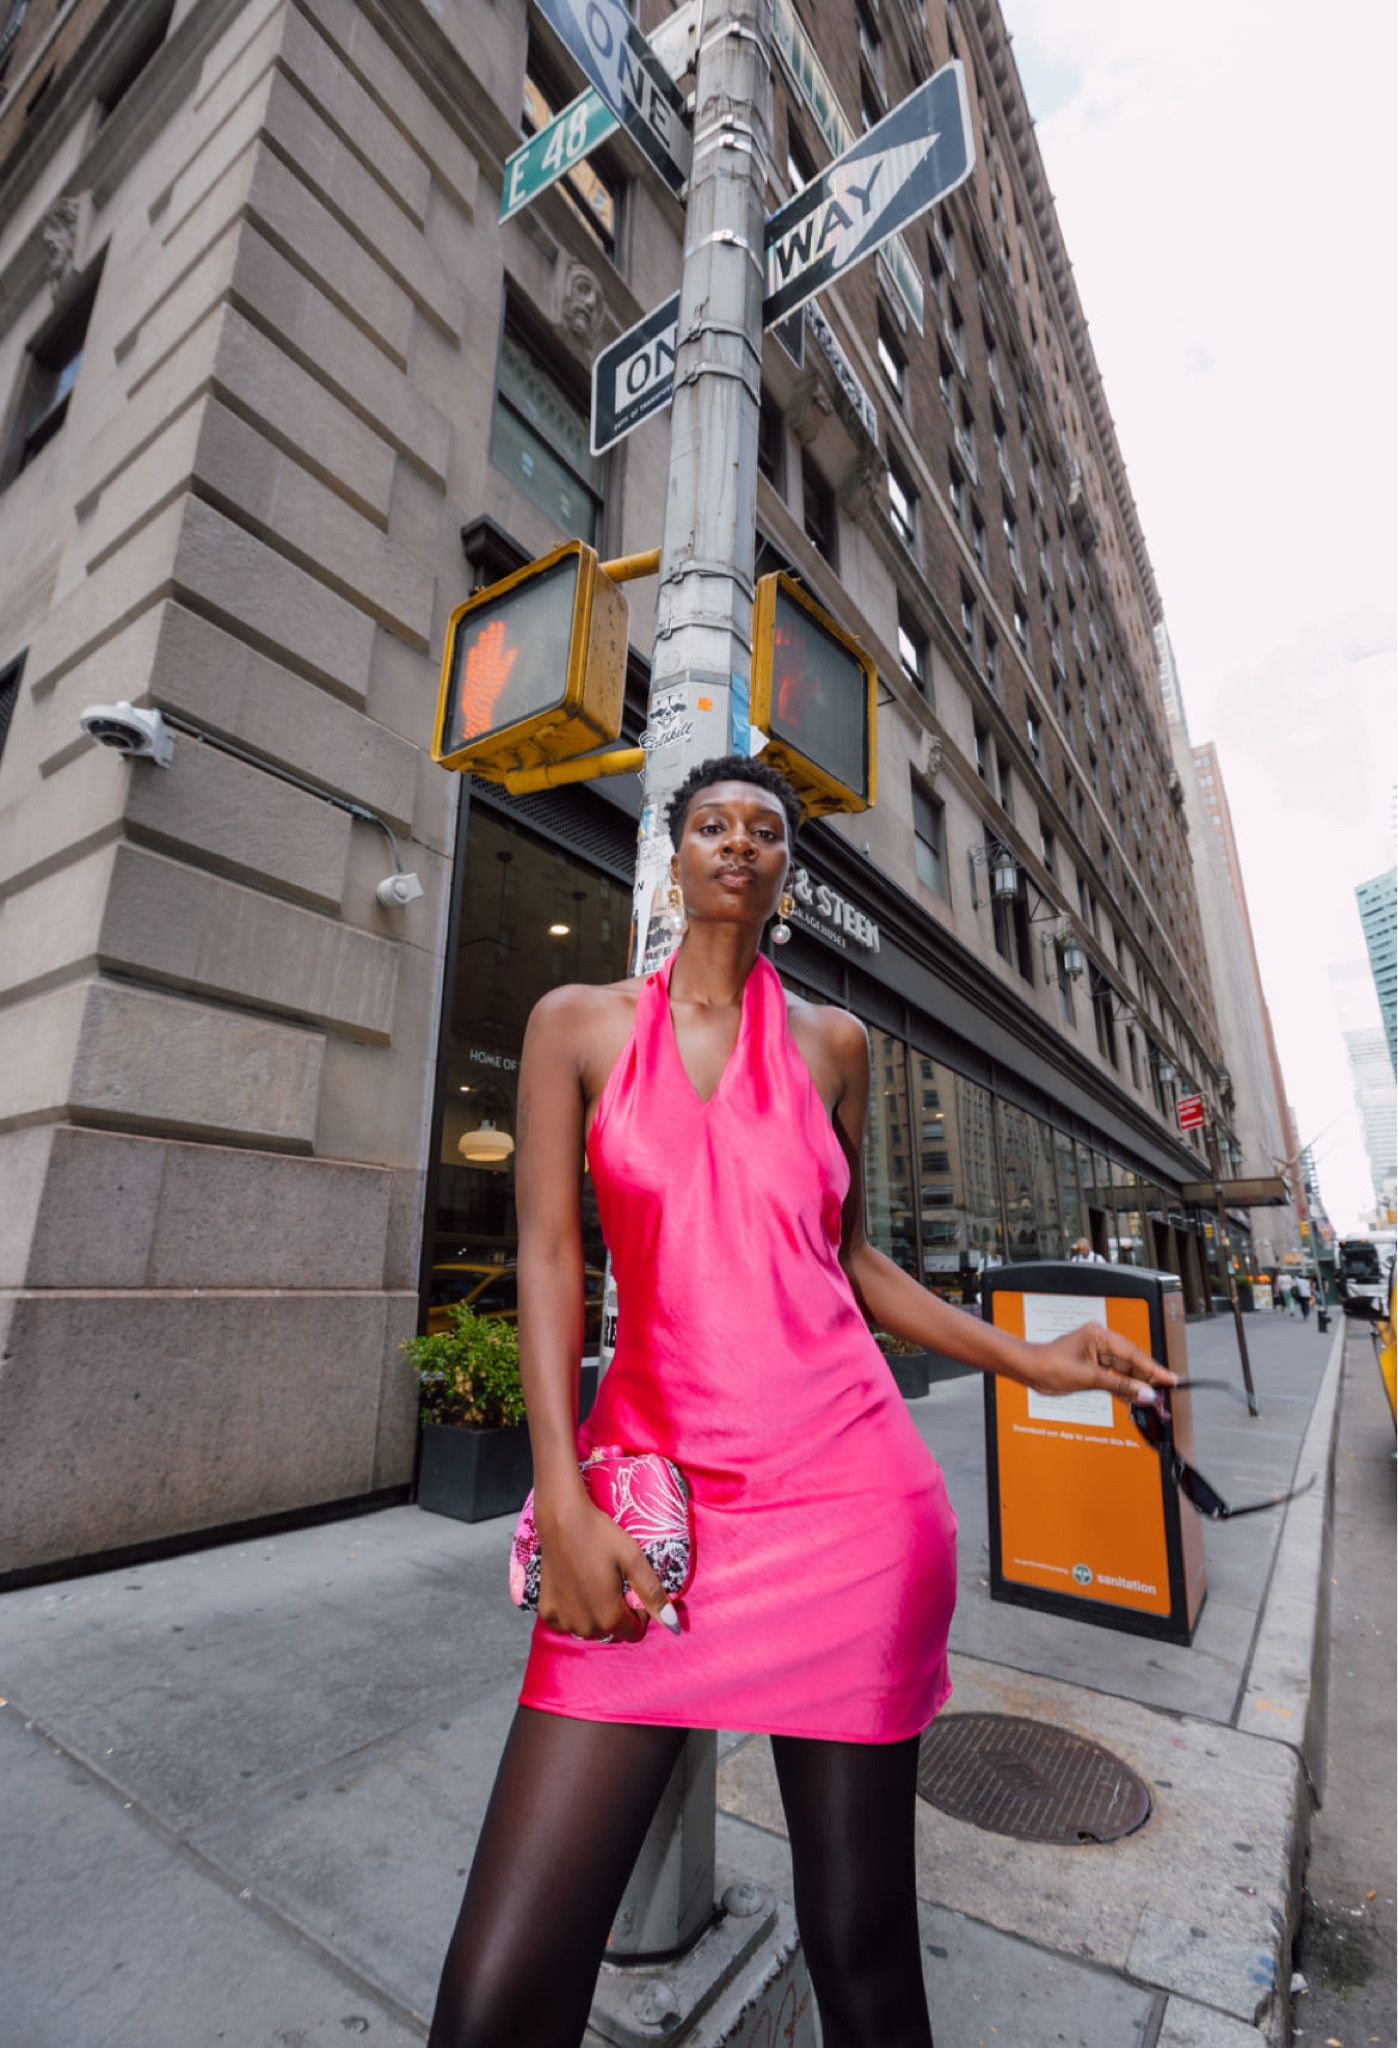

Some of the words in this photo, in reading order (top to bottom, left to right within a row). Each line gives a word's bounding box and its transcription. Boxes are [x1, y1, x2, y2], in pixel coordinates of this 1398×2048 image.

[586, 1, 671, 148] ONE
[508, 151, 530, 209] E
[541, 102, 588, 170] 48
[776, 158, 885, 278] WAY
[627, 327, 678, 395] ON
[794, 868, 813, 906] &
[816, 885, 880, 953] STEEN
[469, 1048, 502, 1069] HOME
[503, 1058, 518, 1071] OF
[1097, 1573, 1157, 1595] sanitation
